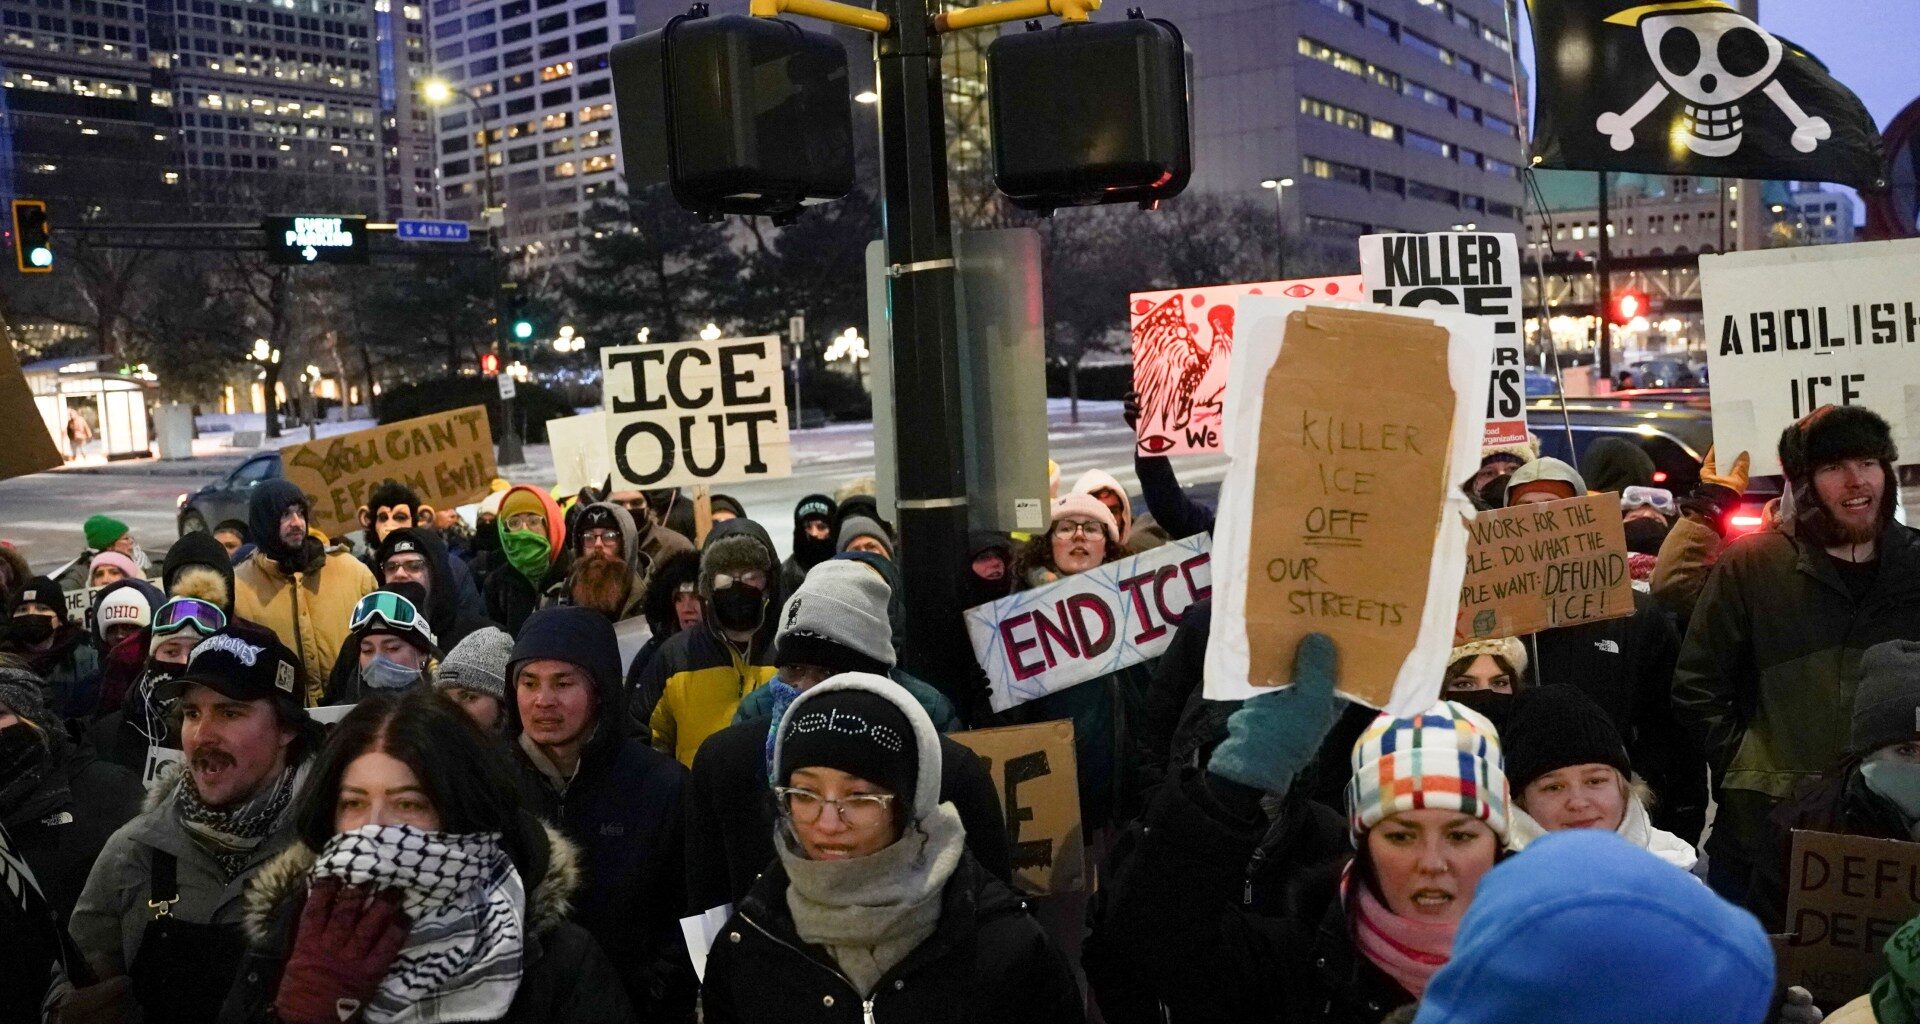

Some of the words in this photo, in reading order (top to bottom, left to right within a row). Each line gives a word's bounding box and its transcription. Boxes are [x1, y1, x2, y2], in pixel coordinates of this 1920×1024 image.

[286, 230, 353, 247] PARKING
[295, 217, 342, 233] EVENT
[406, 223, 414, 236] S
[419, 223, 441, 236] 4th
[446, 224, 461, 237] Av
[1383, 234, 1503, 287] KILLER
[1720, 302, 1920, 356] ABOLISH
[609, 342, 771, 414] ICE
[1791, 374, 1865, 420] ICE
[289, 437, 384, 486] YOU
[385, 410, 482, 461] CAN'T
[615, 410, 778, 486] OUT
[1185, 424, 1219, 448] We
[1303, 410, 1423, 456] KILLER
[1318, 463, 1376, 496] ICE
[1305, 506, 1369, 535] OFF
[1470, 516, 1530, 546] WORK
[1532, 510, 1559, 533] FOR
[1563, 503, 1597, 529] THE
[1501, 546, 1525, 567] DO
[1528, 535, 1572, 562] WHAT
[1574, 531, 1606, 553] THE
[1266, 557, 1328, 585] OUR
[1493, 571, 1542, 600] WANT:
[1544, 553, 1625, 597] DEFUND
[105, 604, 139, 620] OHIO
[998, 592, 1116, 682] END
[1118, 552, 1213, 646] ICE
[1287, 588, 1409, 627] STREETS
